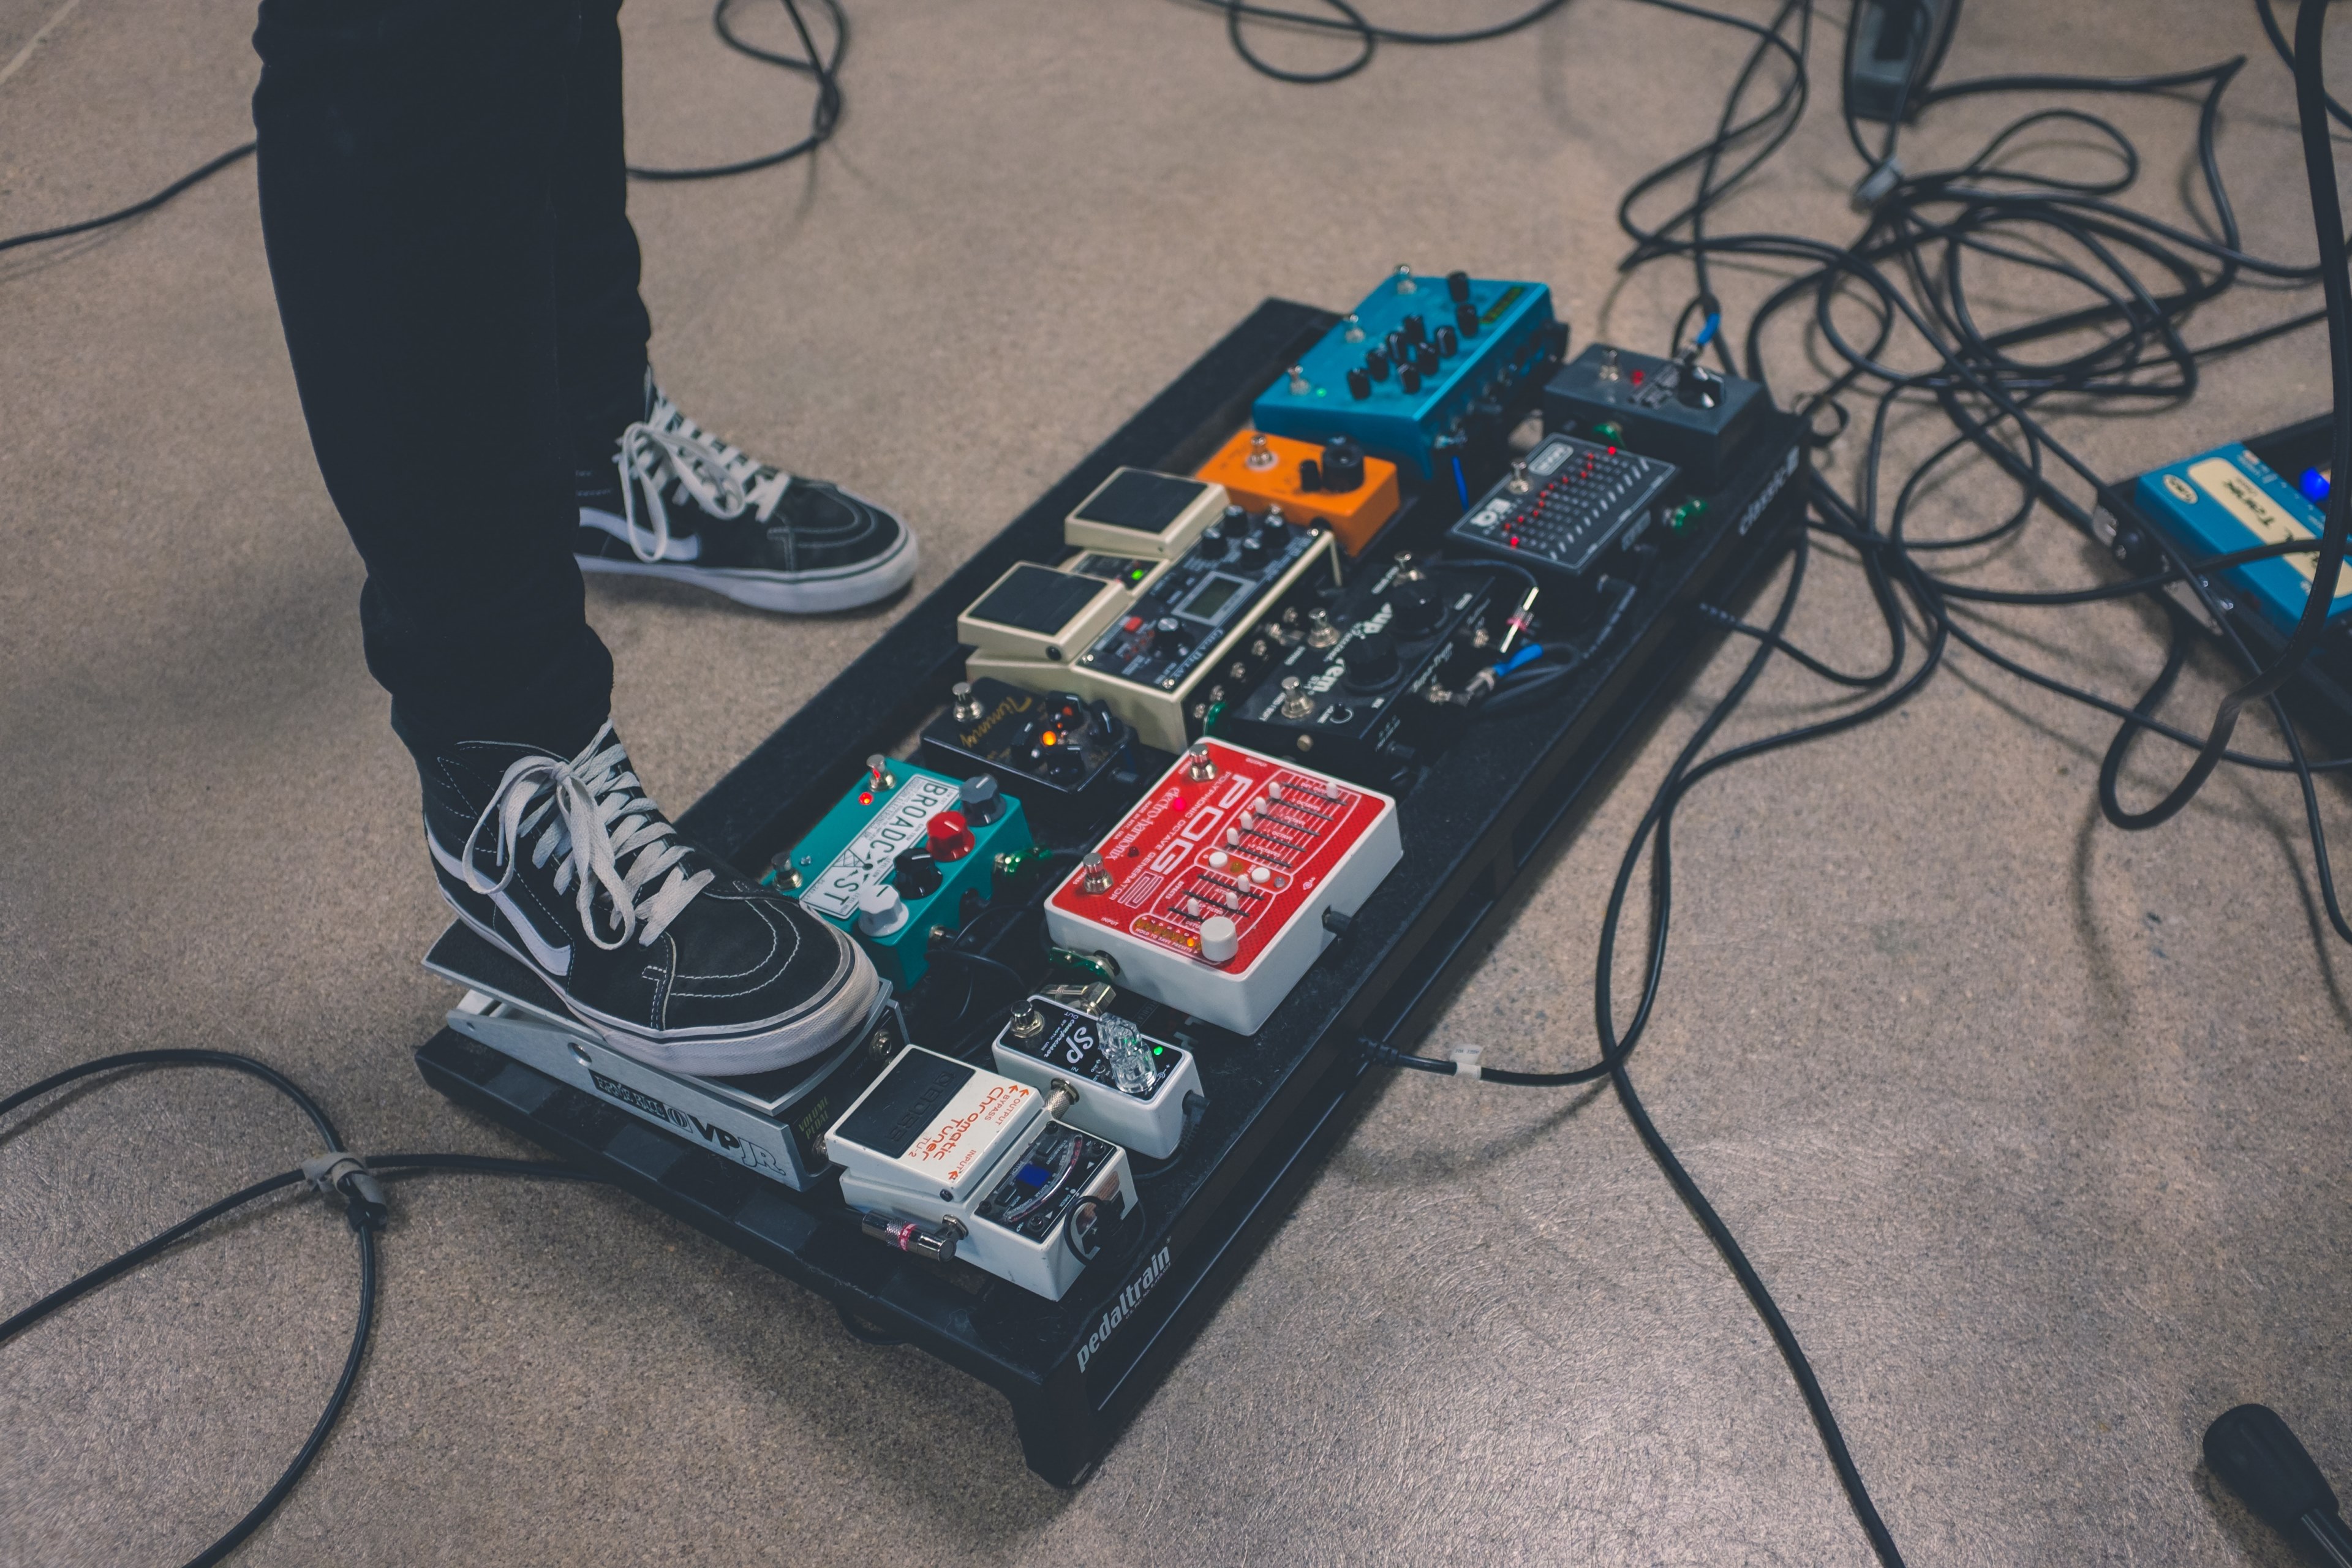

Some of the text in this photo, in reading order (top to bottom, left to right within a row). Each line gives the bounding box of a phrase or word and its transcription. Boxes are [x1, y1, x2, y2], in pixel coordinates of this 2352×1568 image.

[1103, 785, 1185, 864] electro-harmonix
[1107, 770, 1232, 901] POLYPHONIC OCTAVE GENERATOR
[1116, 772, 1255, 910] POG2
[1164, 880, 1185, 900] EFFECTS
[1099, 916, 1119, 926] INPUT
[1134, 927, 1150, 936] HOLD
[1170, 941, 1193, 952] PRESETS
[983, 1093, 1011, 1121] BYPASS
[993, 1097, 1022, 1126] OUTPUT
[932, 1084, 1006, 1163] Chromatic
[907, 1134, 932, 1158] TU-2
[916, 1115, 964, 1163] Tuner
[954, 1148, 978, 1171] INPUT
[1077, 1246, 1171, 1373] pedaltrain
